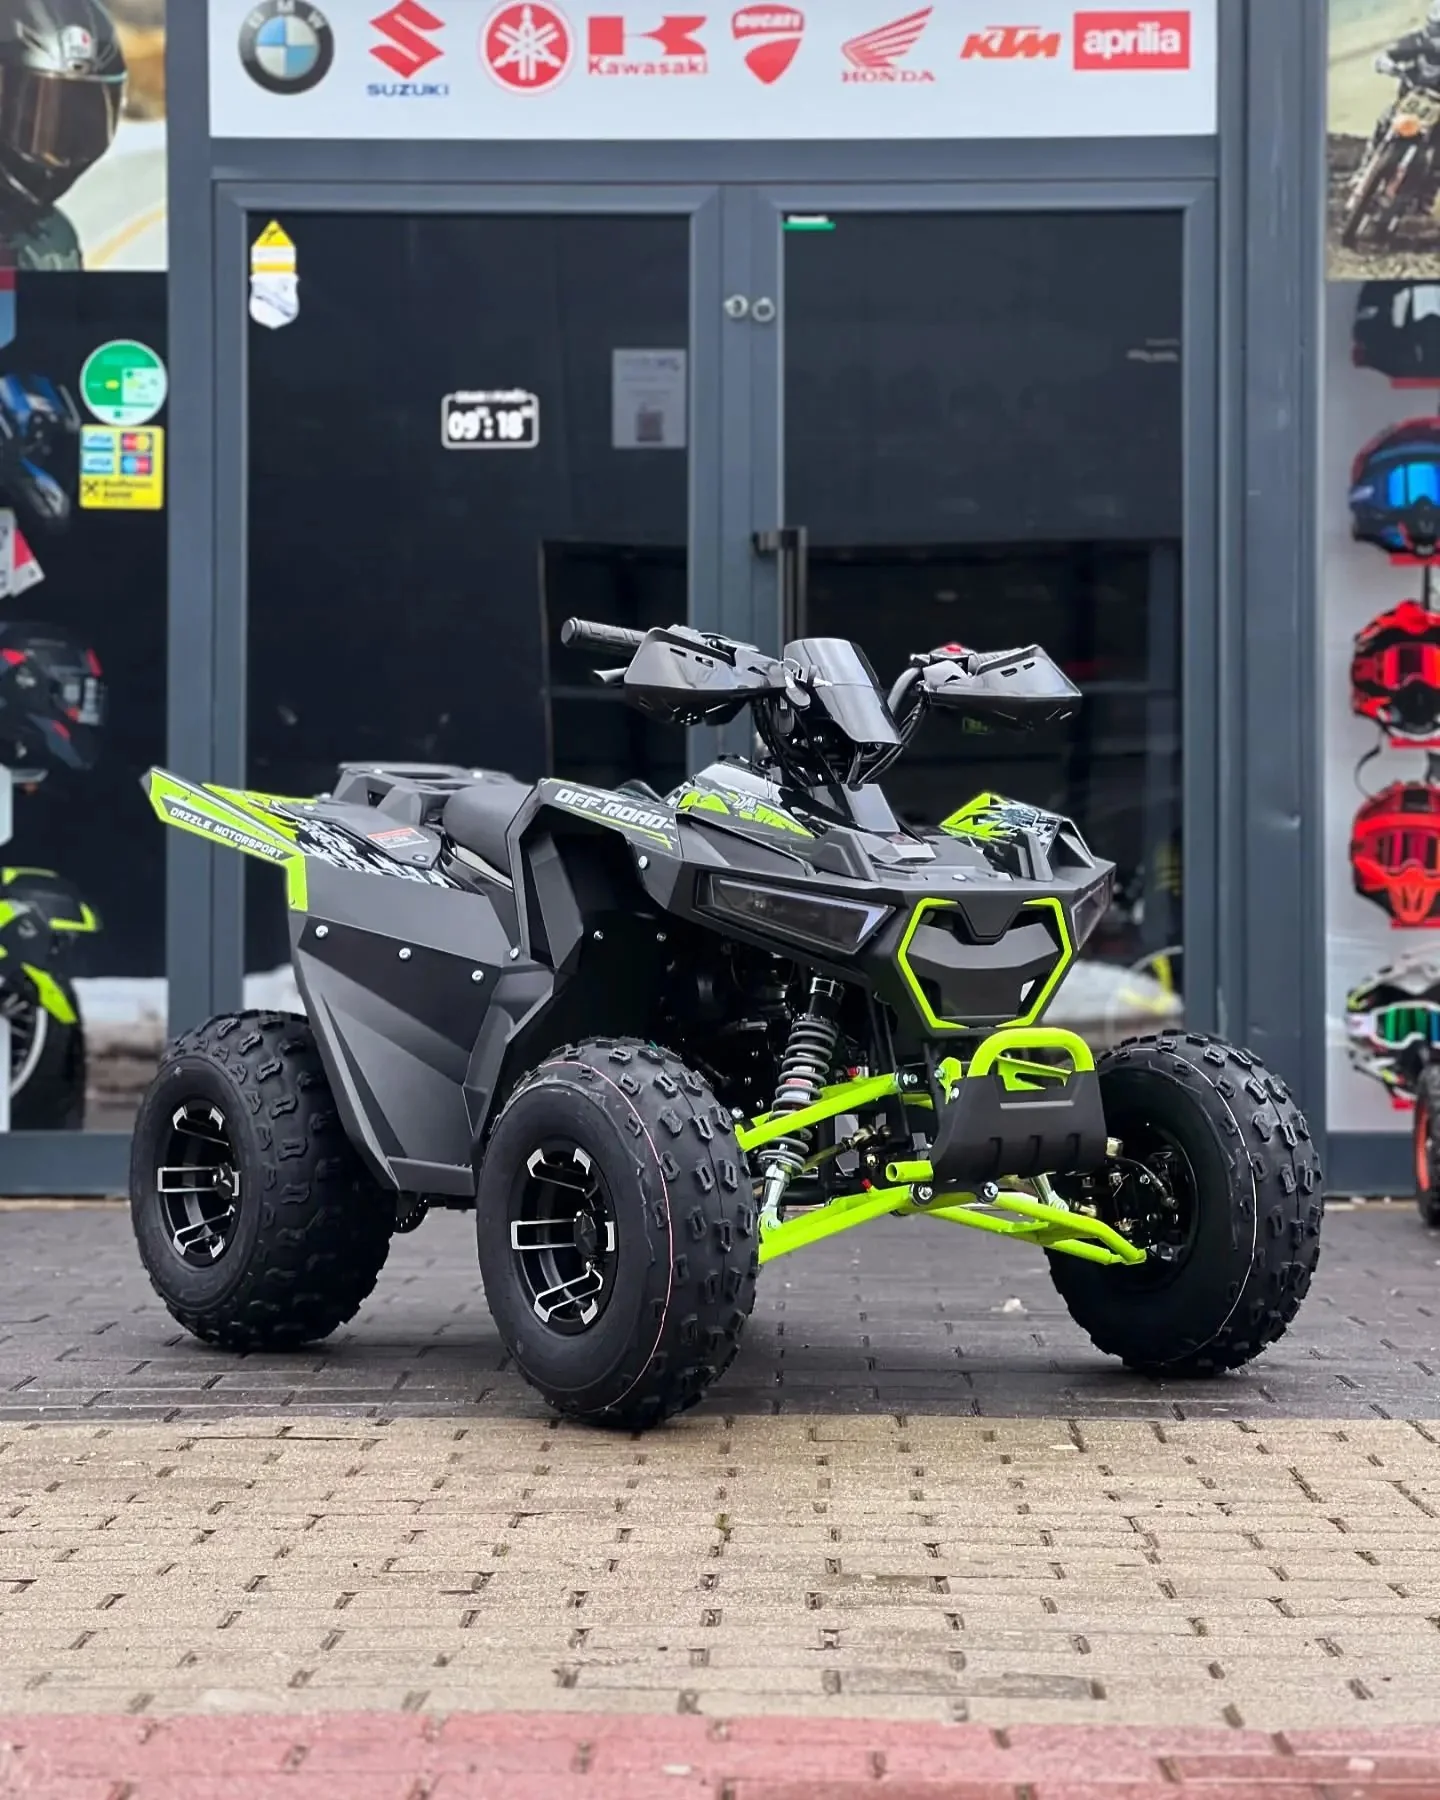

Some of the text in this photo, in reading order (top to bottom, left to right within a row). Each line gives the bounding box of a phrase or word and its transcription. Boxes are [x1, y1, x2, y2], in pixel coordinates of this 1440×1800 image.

[248, 0, 327, 29] BMW
[734, 13, 799, 28] DUCATI
[959, 25, 1061, 59] KTM
[1083, 21, 1181, 60] aprilia
[588, 59, 708, 75] Kawasaki
[842, 70, 935, 82] HONDA
[367, 83, 449, 97] SUZUKI
[213, 823, 284, 859] MOTORSPORT
